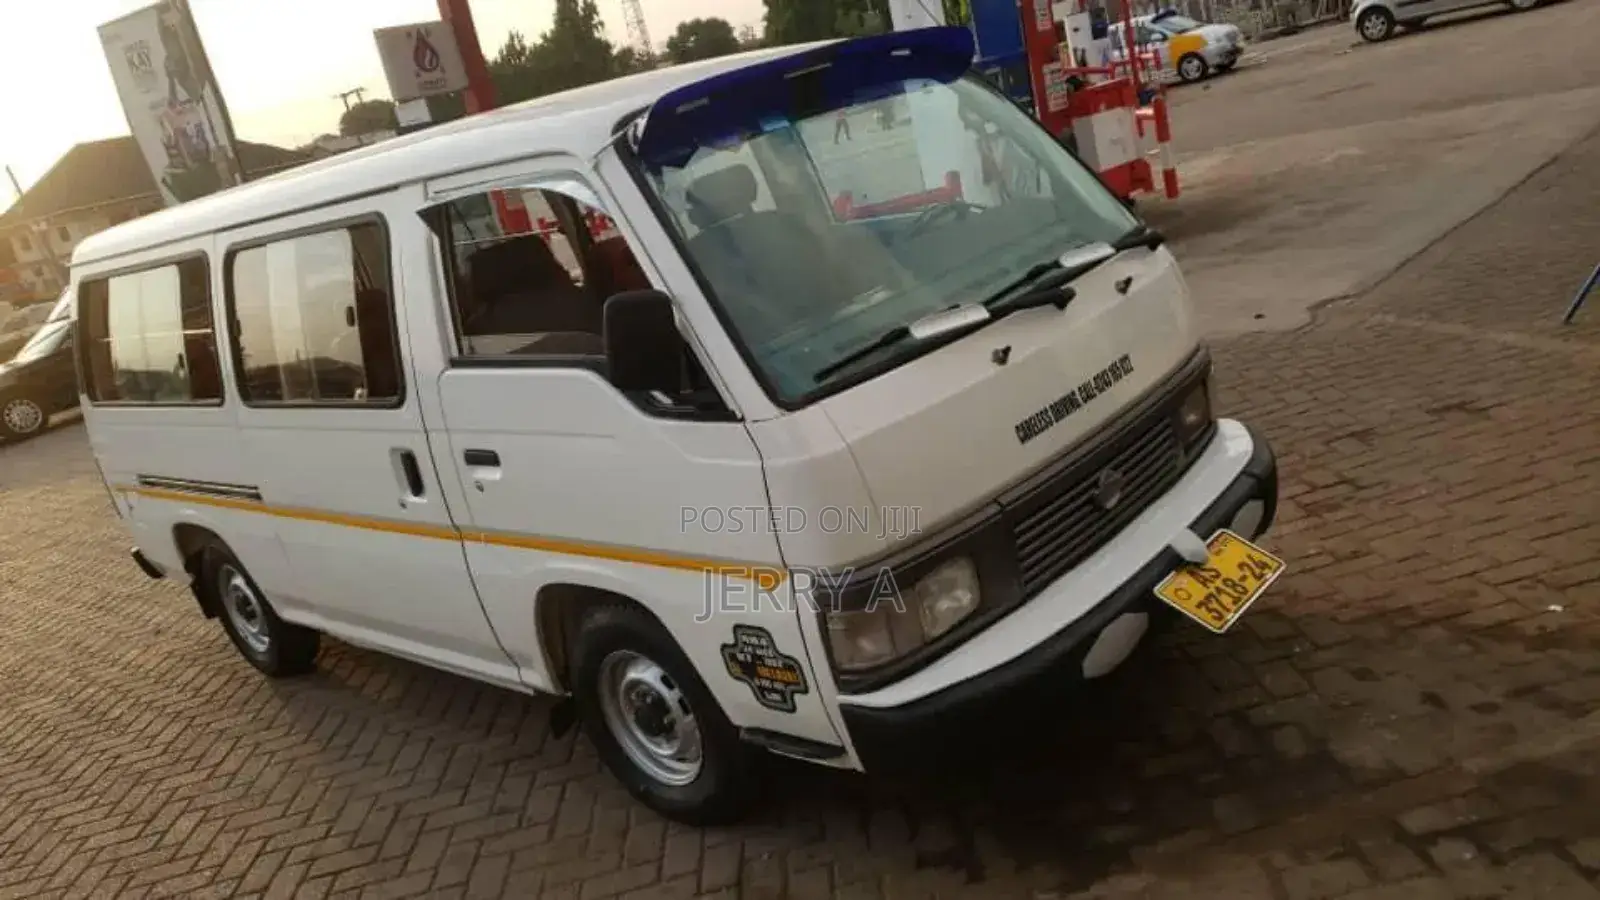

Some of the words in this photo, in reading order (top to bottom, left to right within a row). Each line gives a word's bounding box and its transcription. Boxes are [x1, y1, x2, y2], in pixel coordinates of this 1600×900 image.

[1015, 405, 1054, 444] CARELESS
[1049, 390, 1082, 423] DRIVING
[1195, 553, 1272, 621] 3718-24
